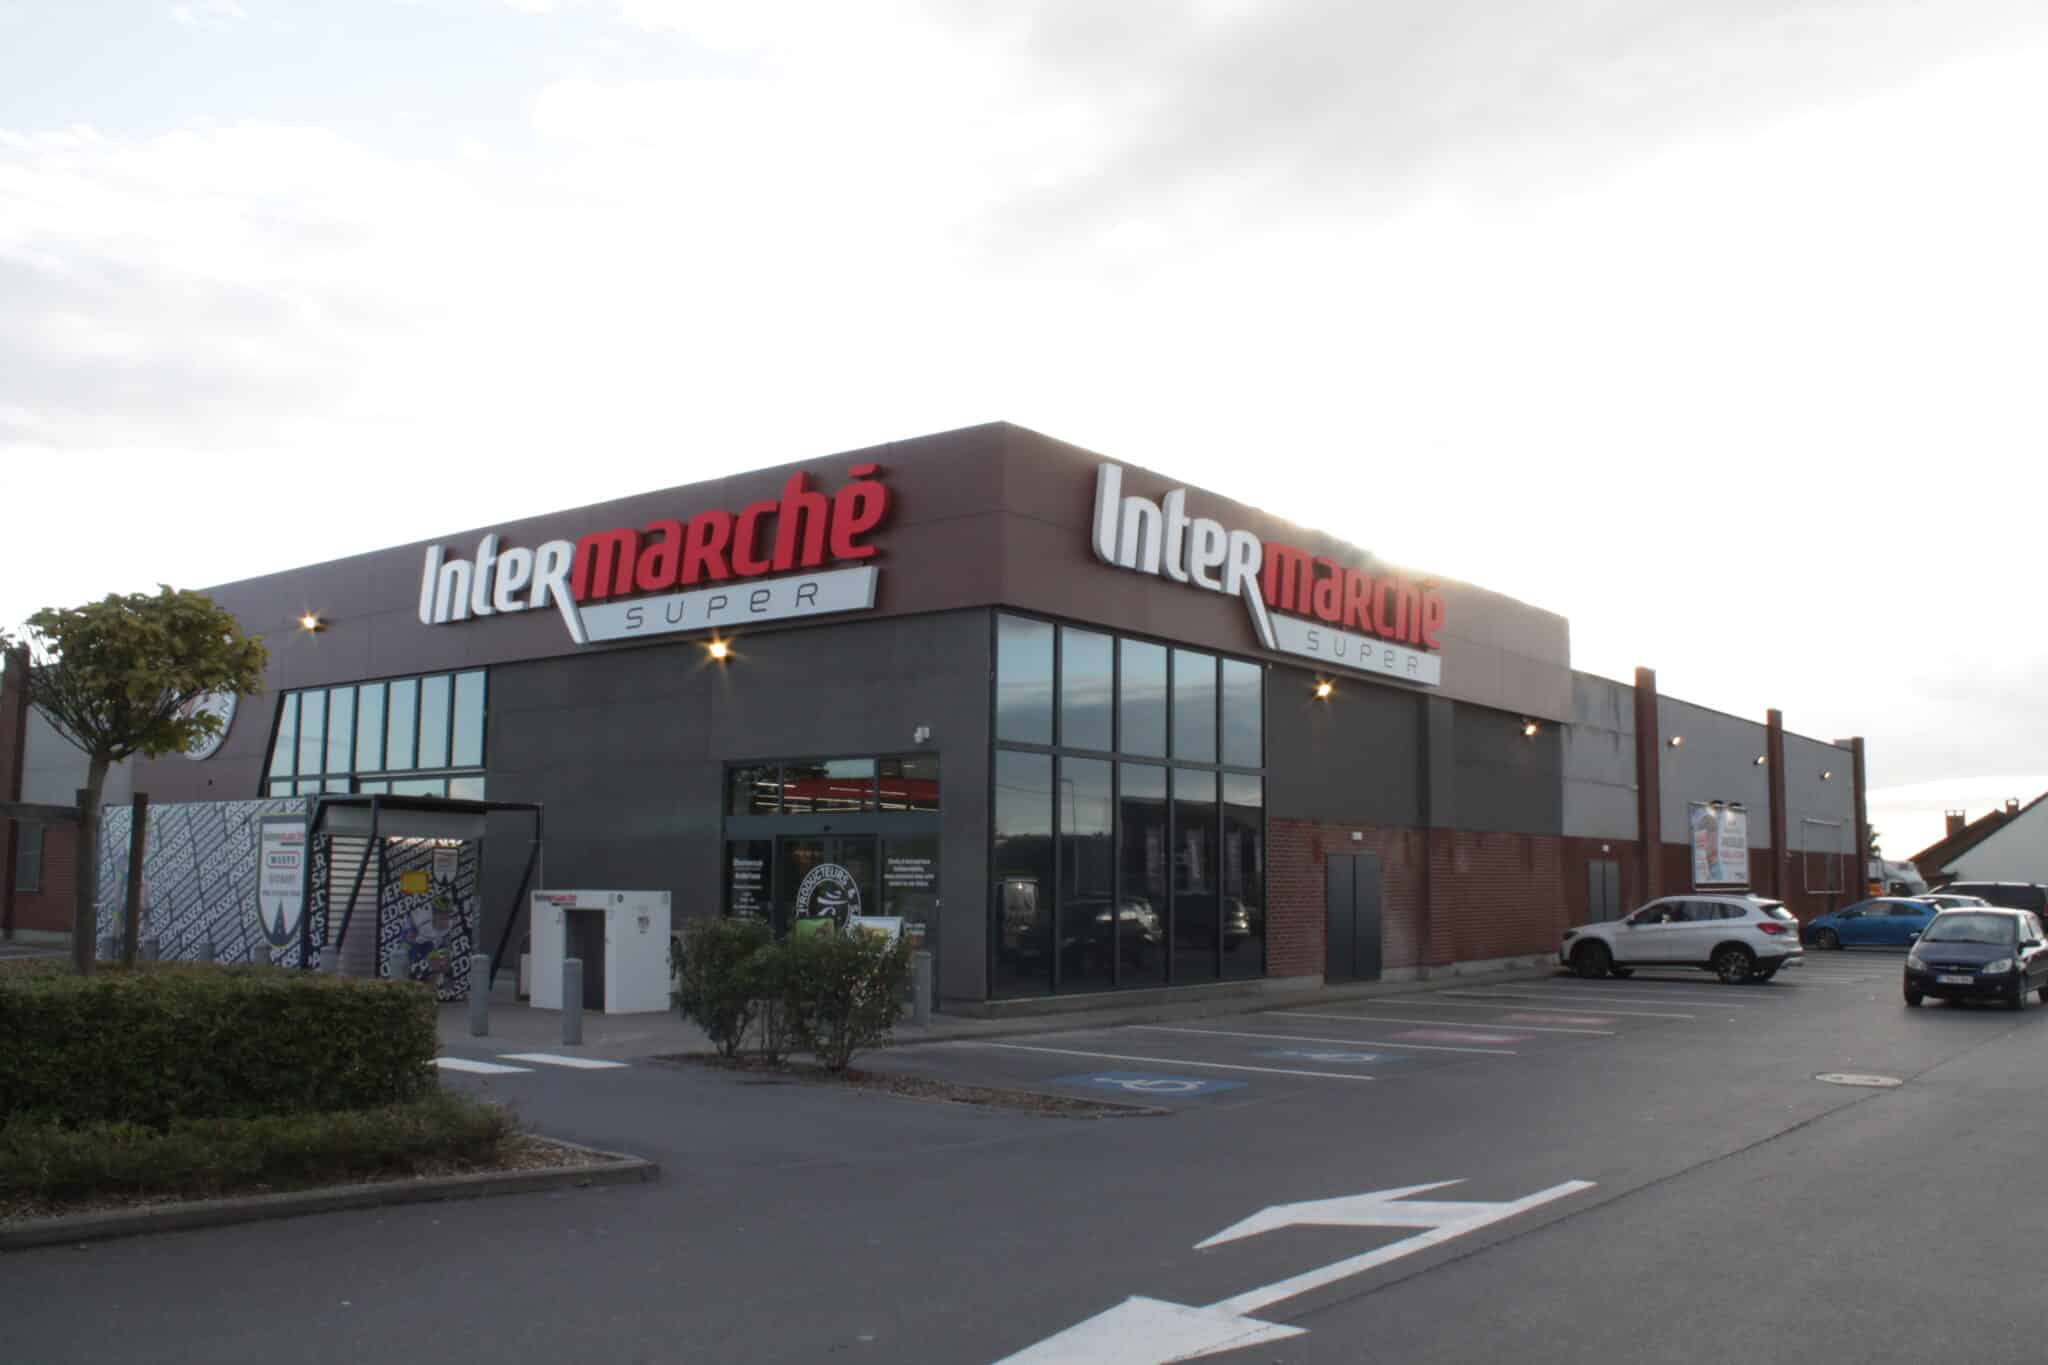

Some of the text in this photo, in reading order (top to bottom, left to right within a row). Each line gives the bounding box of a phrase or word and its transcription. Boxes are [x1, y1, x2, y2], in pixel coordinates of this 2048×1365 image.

[419, 464, 888, 643] Intermarché
[625, 582, 820, 630] SUPER
[1305, 630, 1420, 676] SUPER
